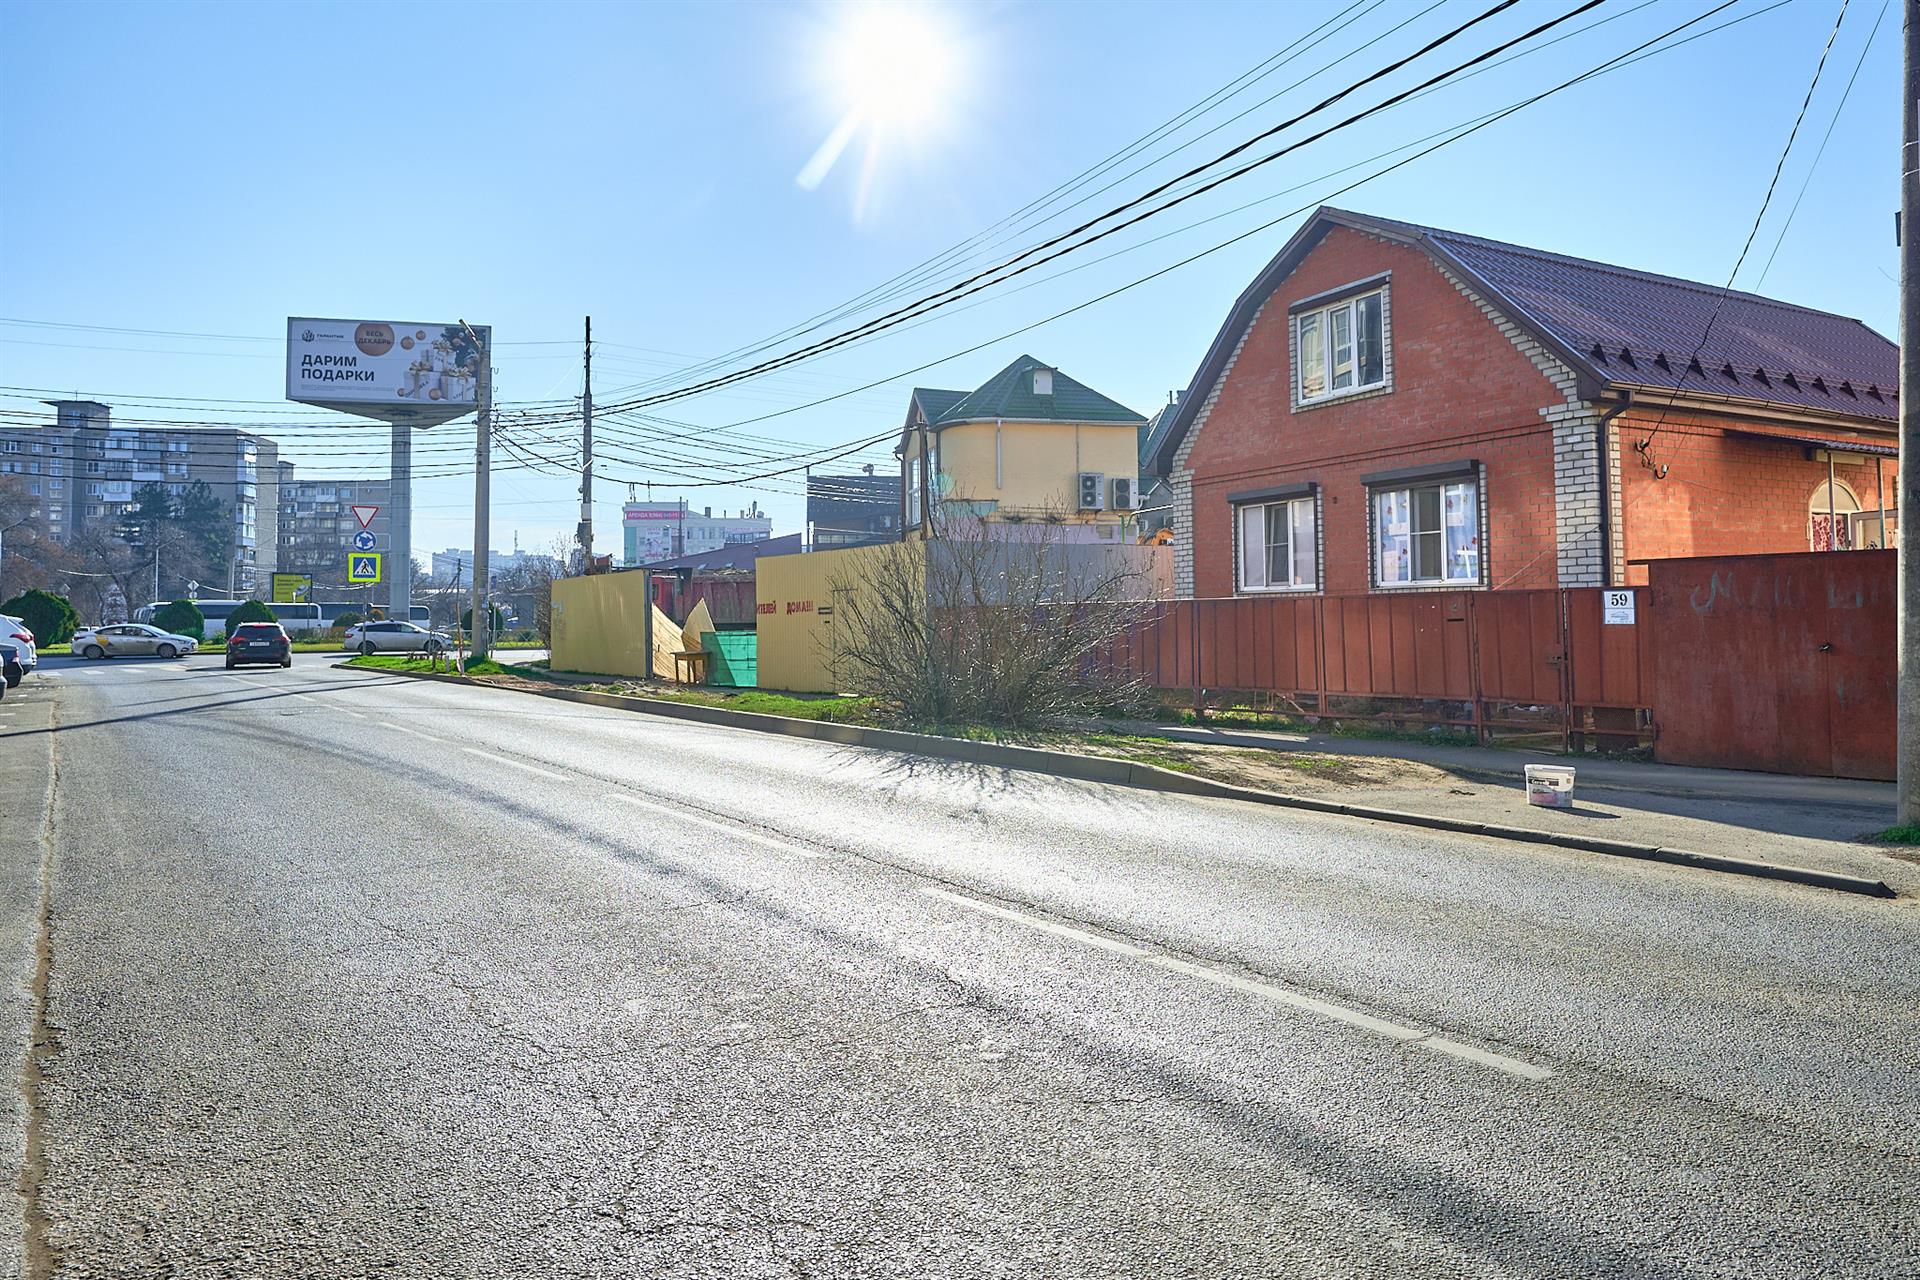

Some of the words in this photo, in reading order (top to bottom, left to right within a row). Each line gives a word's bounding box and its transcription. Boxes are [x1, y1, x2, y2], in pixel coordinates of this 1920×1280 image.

[357, 337, 391, 345] ДЕКАБРЬ
[301, 354, 357, 367] ДАРИМ
[301, 368, 375, 382] ПОДАРКИ
[1611, 593, 1628, 606] 59
